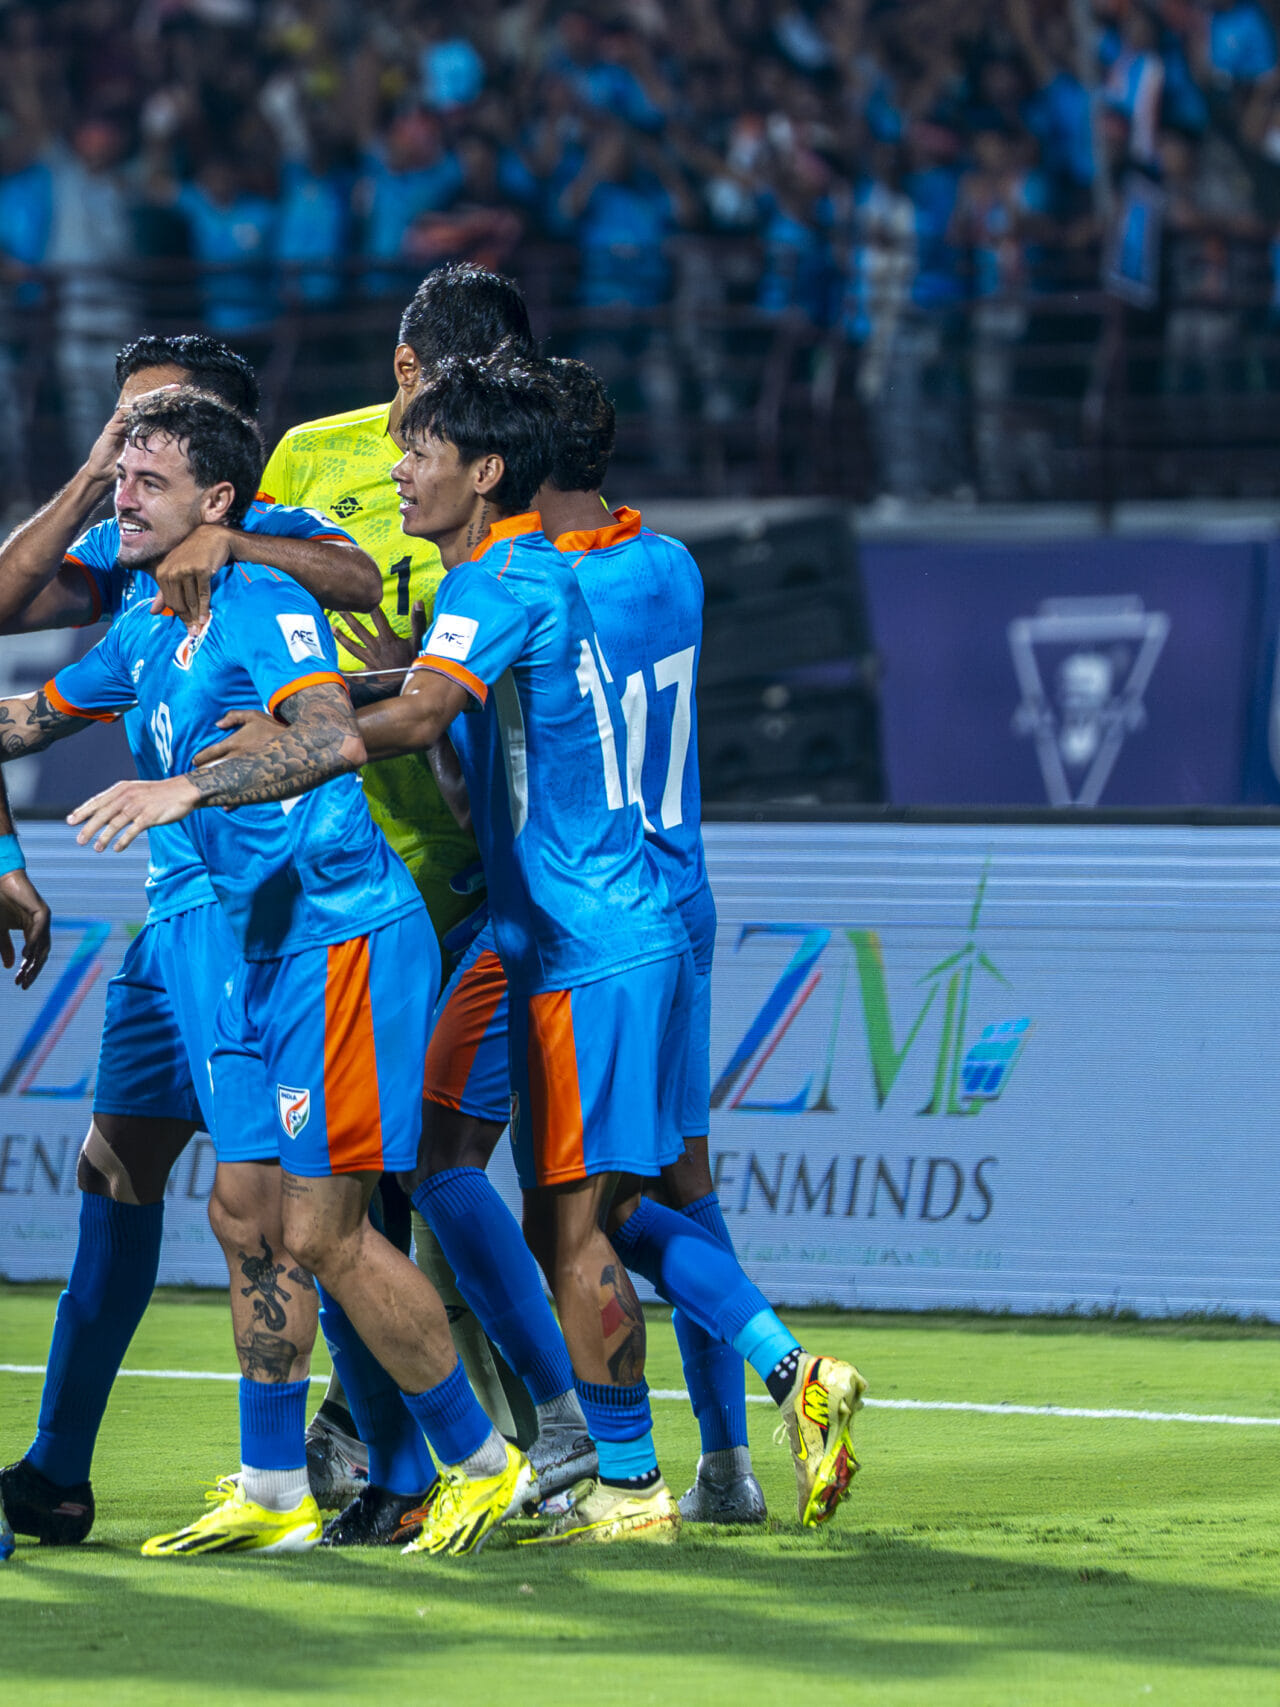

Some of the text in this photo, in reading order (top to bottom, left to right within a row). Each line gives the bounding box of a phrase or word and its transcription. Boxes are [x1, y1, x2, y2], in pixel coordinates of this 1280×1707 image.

[390, 555, 412, 615] 1
[621, 645, 696, 831] 17
[712, 1151, 999, 1223] ENMINDS
